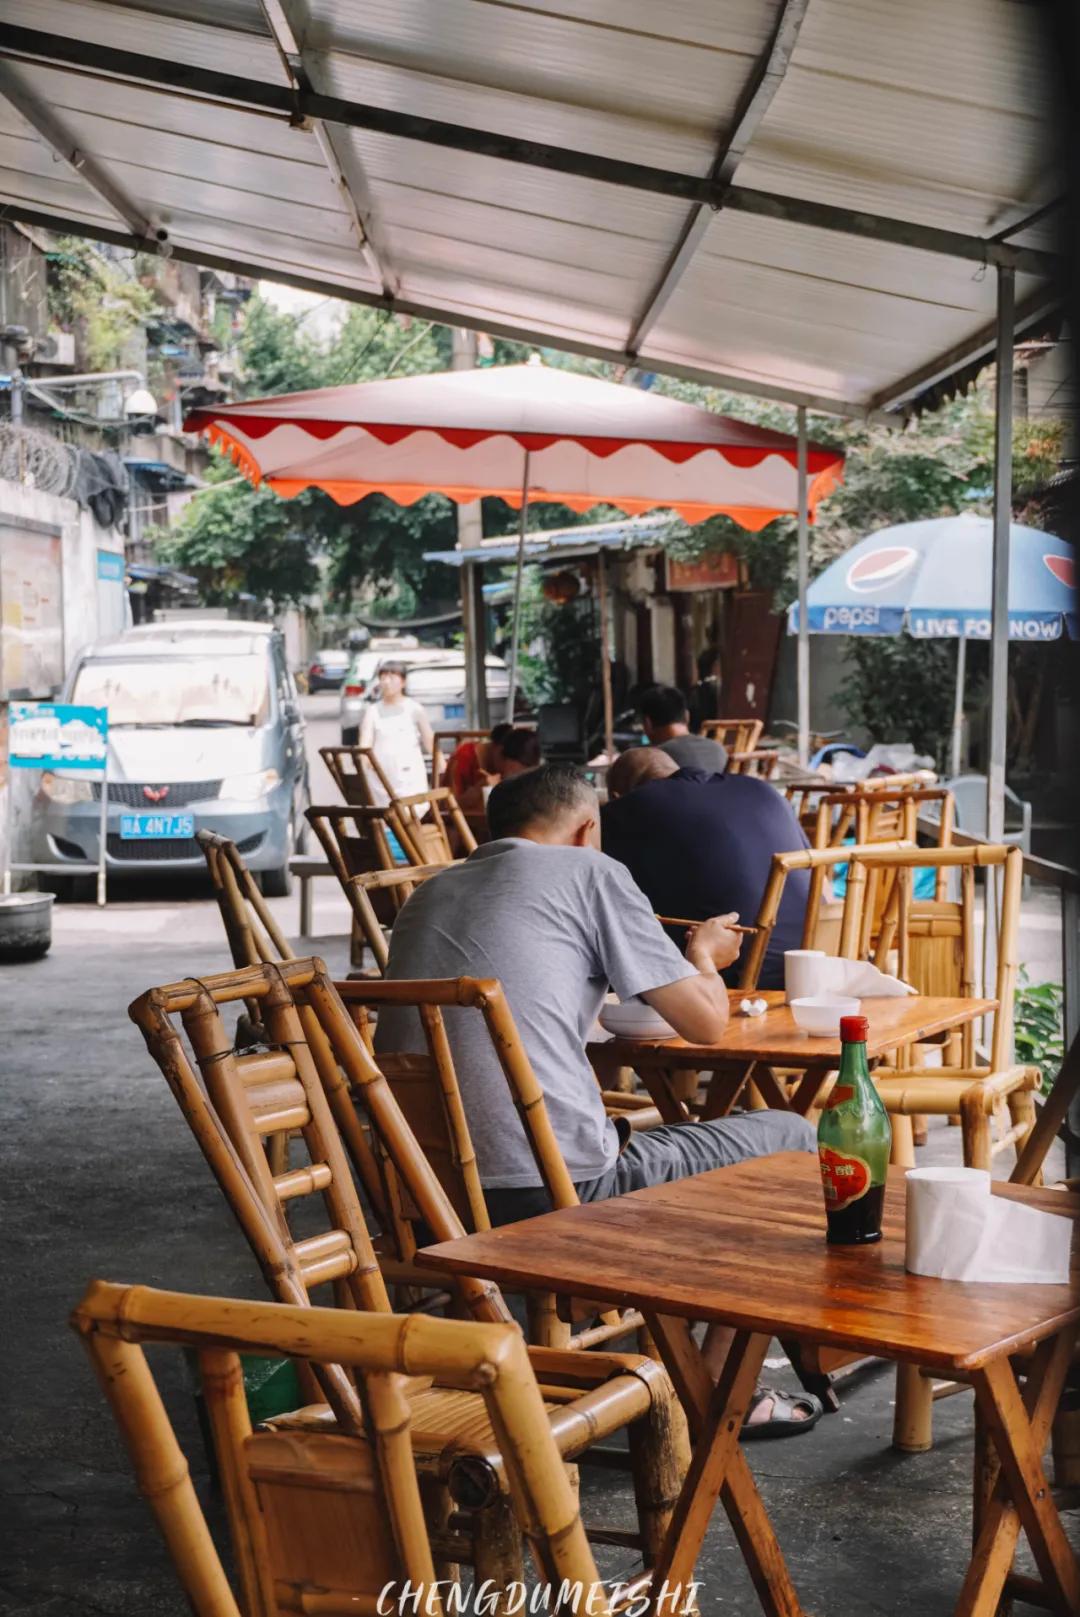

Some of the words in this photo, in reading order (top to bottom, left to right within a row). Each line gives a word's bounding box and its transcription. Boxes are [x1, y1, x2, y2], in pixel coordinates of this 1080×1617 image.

[825, 606, 879, 629] pepsi
[916, 619, 959, 635] LIVE
[965, 620, 992, 636] FO
[1009, 620, 1058, 637] NOW
